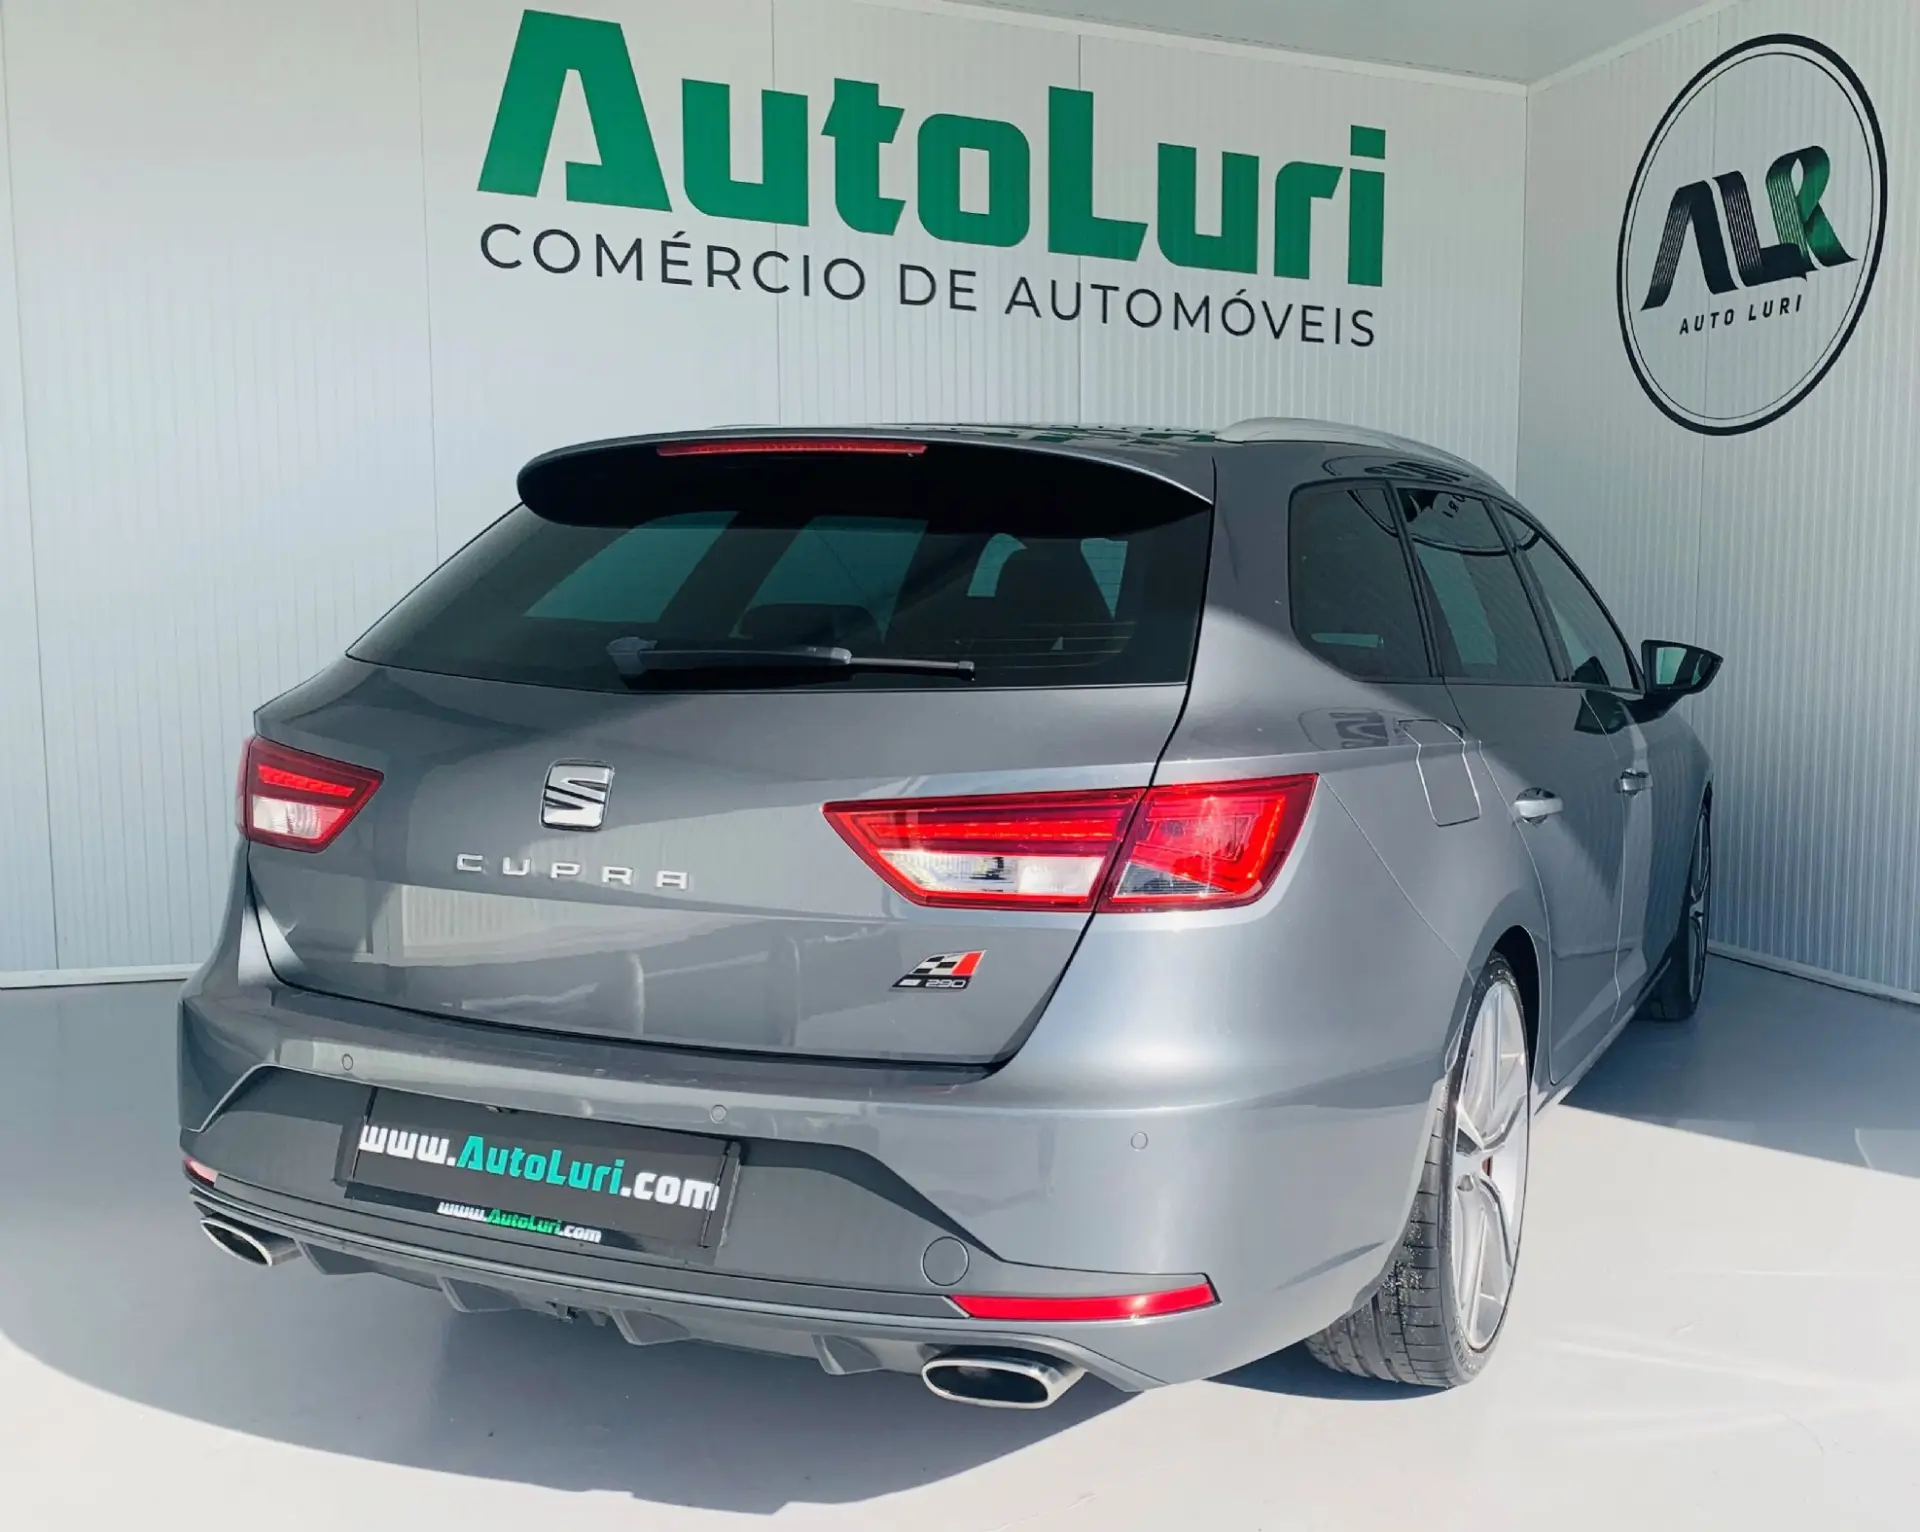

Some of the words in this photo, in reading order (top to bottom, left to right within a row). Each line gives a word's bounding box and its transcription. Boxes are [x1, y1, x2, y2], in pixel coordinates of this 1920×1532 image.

[477, 9, 1386, 287] AutoLuri
[479, 223, 867, 300] COMÉRCIO
[899, 263, 979, 312] DE
[1004, 276, 1376, 347] AUTOMÓVEIS
[1678, 308, 1735, 335] AUTO
[1747, 294, 1802, 322] LURI
[456, 853, 689, 890] CUPRA
[358, 1124, 720, 1212] www.AutoLuri.com
[436, 1201, 602, 1244] www.AutoLuri.com
